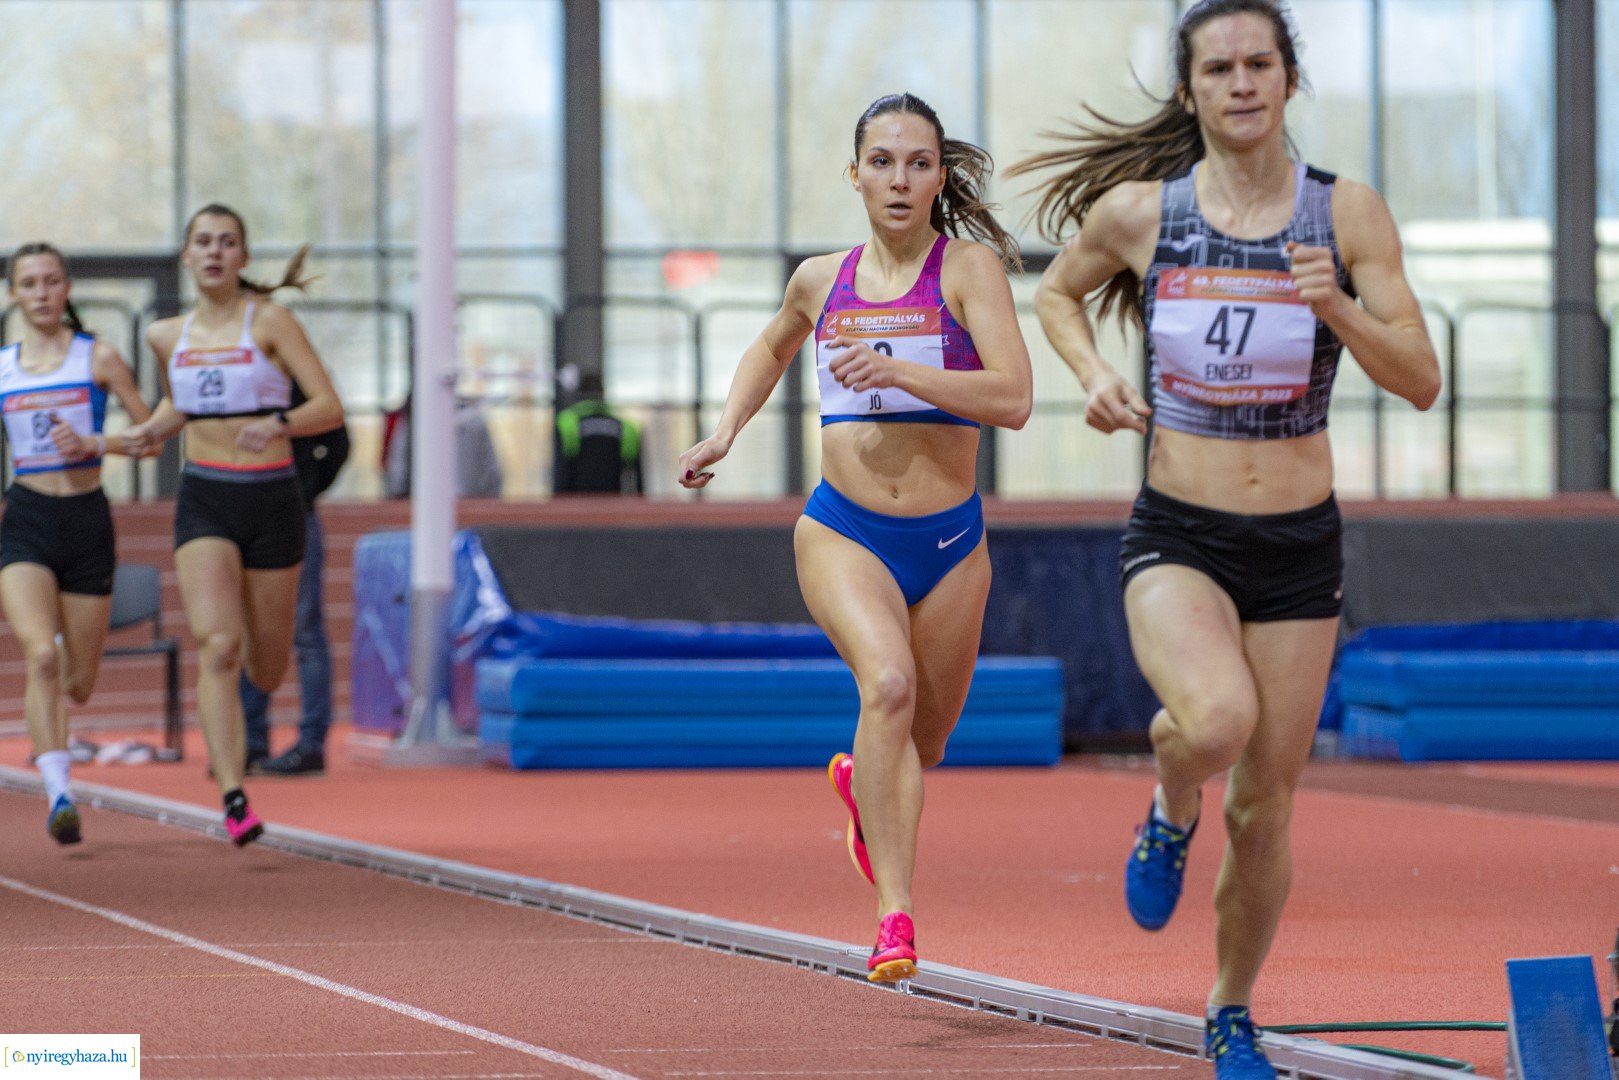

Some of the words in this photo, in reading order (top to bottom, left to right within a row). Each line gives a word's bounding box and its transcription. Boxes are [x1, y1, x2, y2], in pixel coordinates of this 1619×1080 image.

[1212, 275, 1296, 290] FEDETTPÁLYÁ
[854, 312, 926, 325] FEDETTPÁLYÁS
[1205, 305, 1257, 355] 47
[1205, 364, 1253, 381] ENESEI
[197, 369, 224, 397] 29
[869, 391, 882, 410] JÓ
